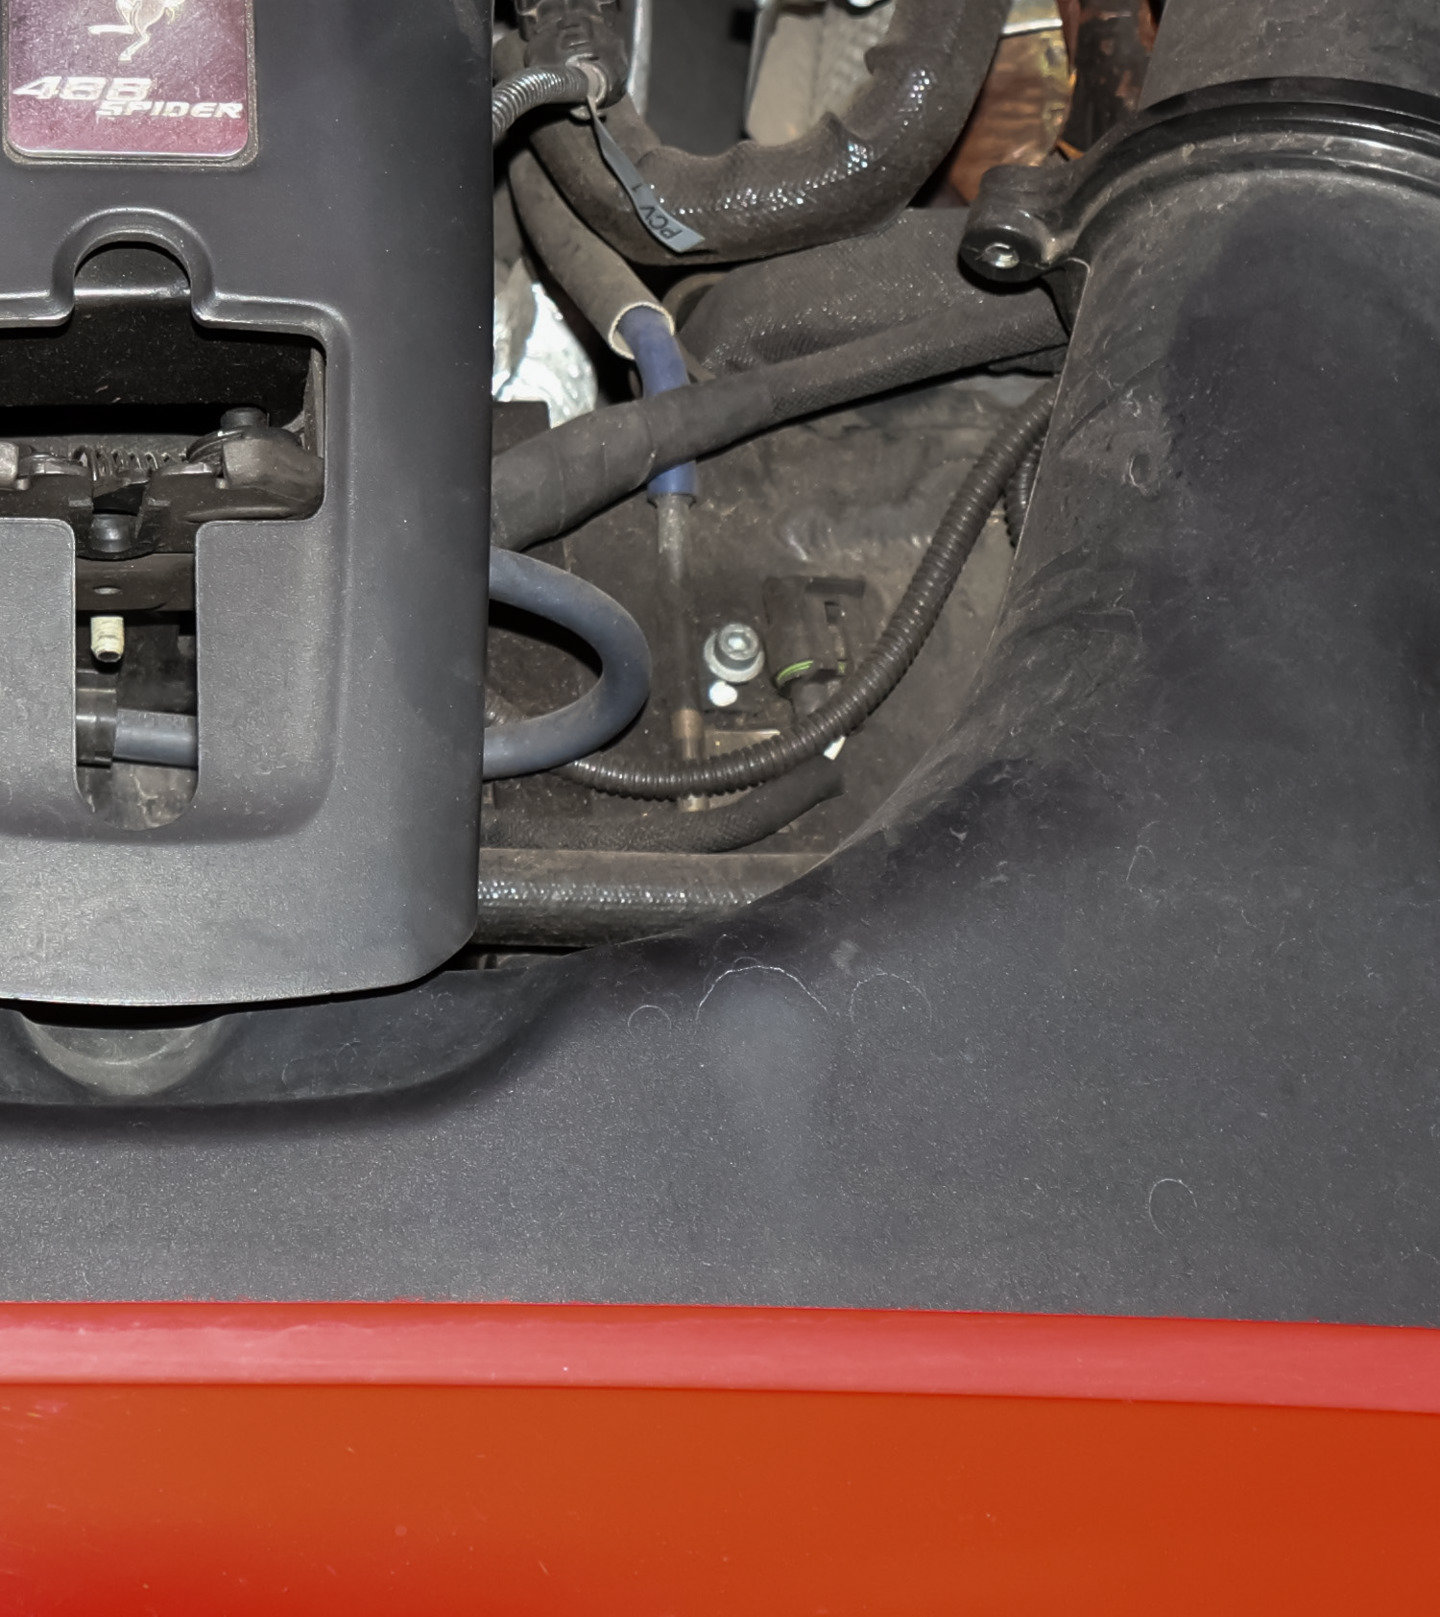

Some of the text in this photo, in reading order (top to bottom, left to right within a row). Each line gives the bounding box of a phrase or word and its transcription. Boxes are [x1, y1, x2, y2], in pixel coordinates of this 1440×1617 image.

[12, 76, 151, 101] 488
[96, 100, 243, 119] SPIDER
[639, 205, 683, 239] PCV
